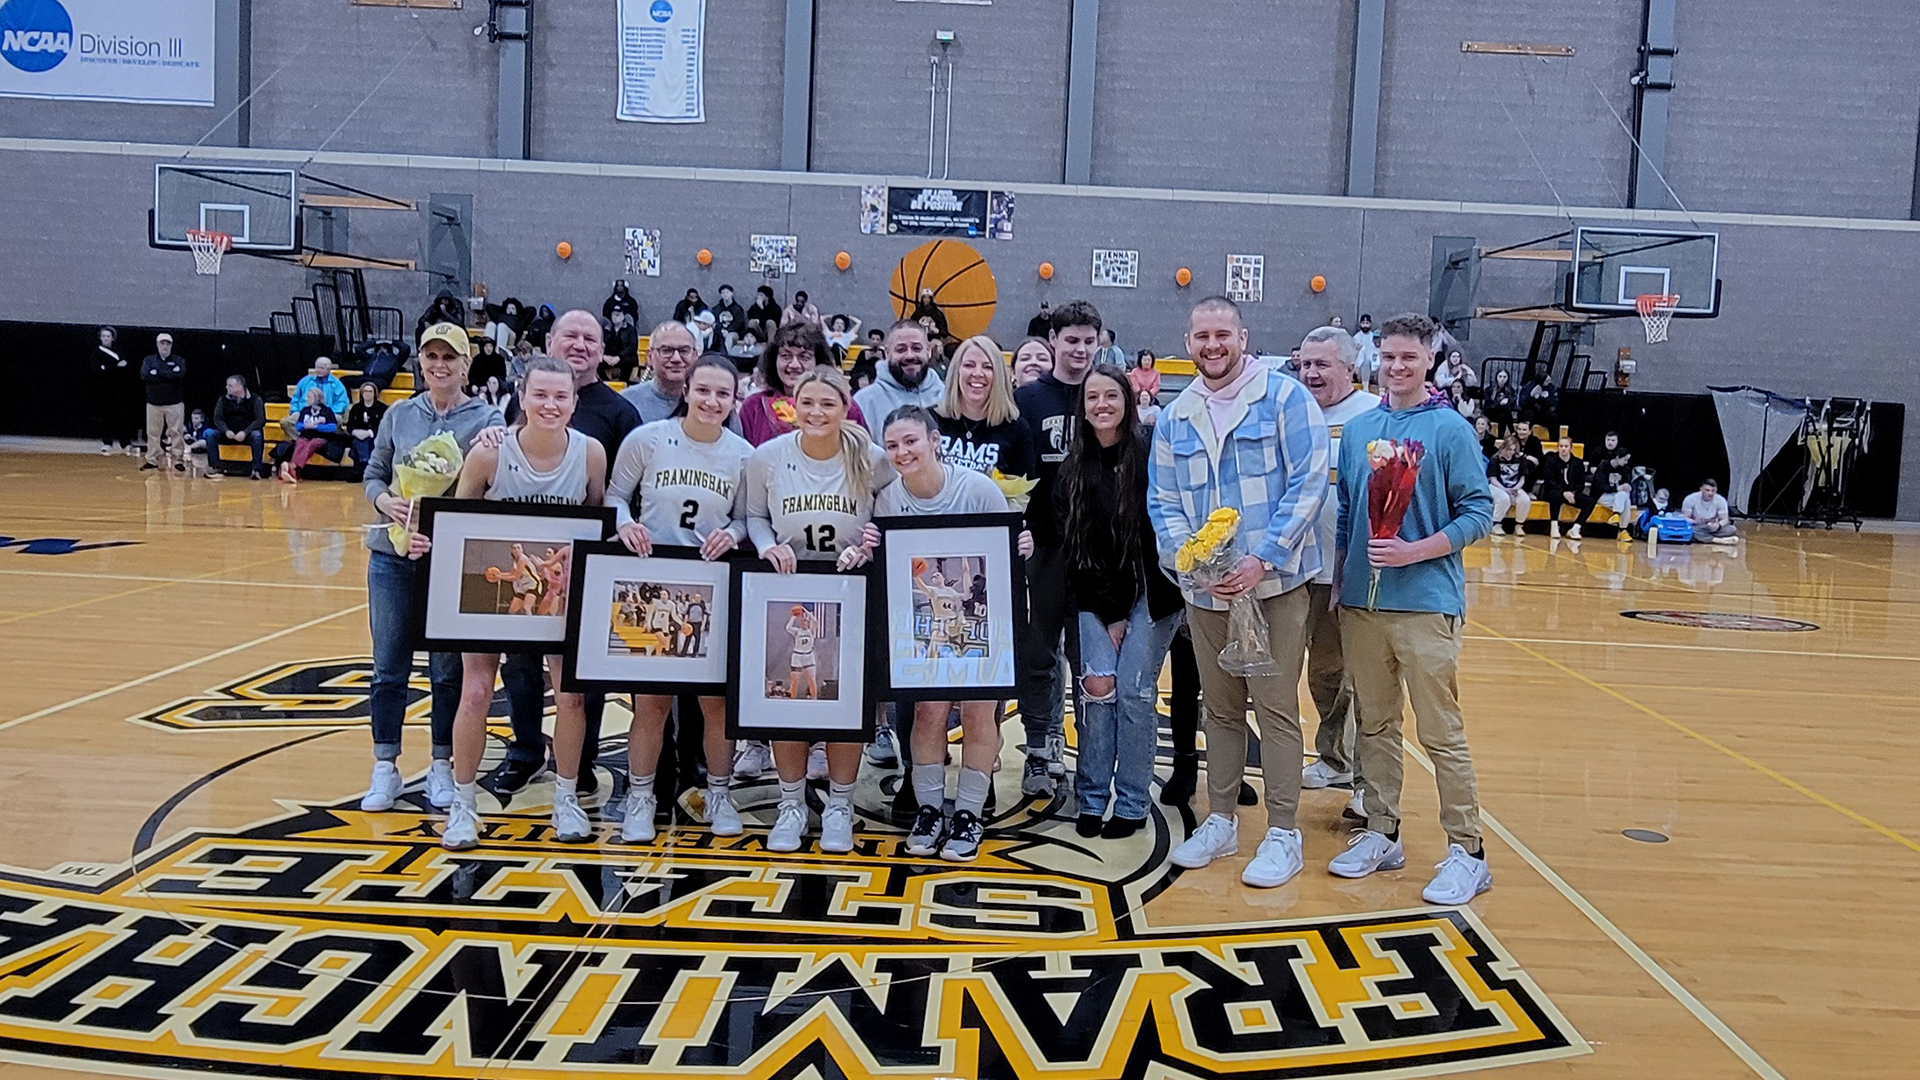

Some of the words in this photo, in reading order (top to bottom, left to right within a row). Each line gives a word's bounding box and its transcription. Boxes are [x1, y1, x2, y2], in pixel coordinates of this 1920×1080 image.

[2, 30, 71, 54] NCAA
[80, 33, 160, 57] Division
[169, 37, 182, 58] III
[910, 200, 923, 210] BE
[924, 201, 963, 211] POSITIVE
[1104, 251, 1129, 259] JENNA
[937, 435, 1000, 466] RAMS
[655, 468, 732, 500] FRAMINGHAM
[679, 498, 699, 531] 2
[781, 494, 858, 517] FRAMINGHAM
[803, 523, 837, 552] 12
[59, 865, 106, 878] TM
[141, 848, 1095, 934] STATE
